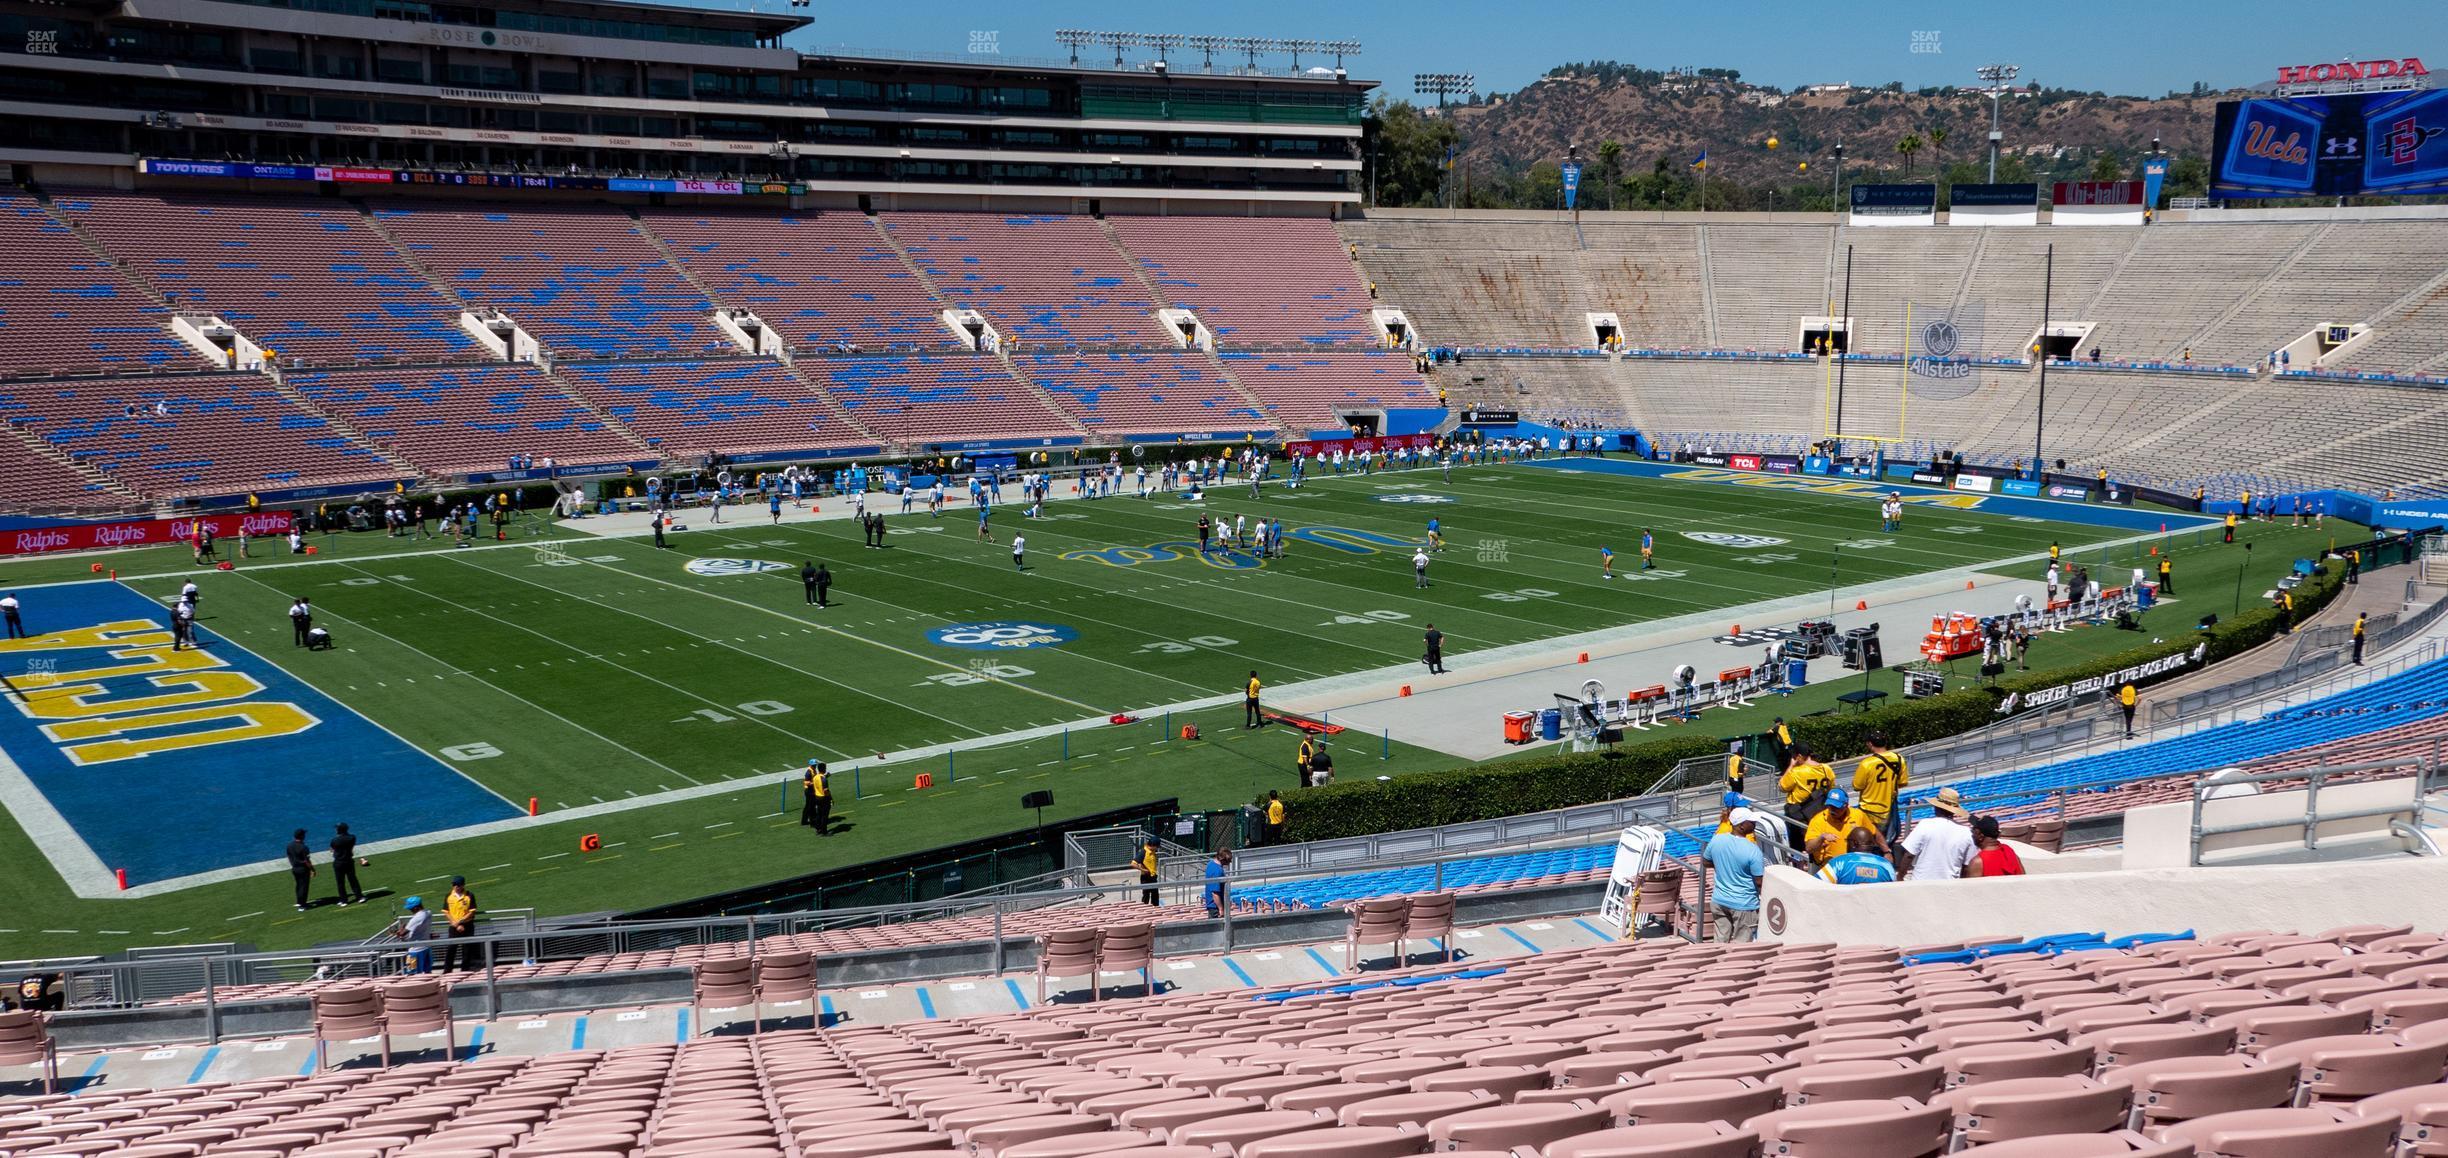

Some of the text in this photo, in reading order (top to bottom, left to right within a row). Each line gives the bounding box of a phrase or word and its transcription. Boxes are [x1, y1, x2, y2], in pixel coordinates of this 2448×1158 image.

[430, 28, 545, 48] ROSE BOWL
[2276, 57, 2430, 85] HONDA
[2245, 121, 2308, 165] Ucla
[155, 163, 224, 174] TOYO TIRES
[252, 166, 296, 175] ONTARIO
[523, 177, 547, 187] 76:41
[683, 181, 705, 191] TCL
[714, 182, 738, 191] TCL
[2328, 327, 2348, 343] 40
[1909, 358, 1970, 379] Allstate
[1353, 440, 1374, 451] Ralphs
[570, 464, 628, 474] UNDER ARMOUR
[1696, 456, 1724, 465] NISSAN
[1734, 458, 1756, 468] TCL
[1659, 469, 1989, 509] UCLA
[2395, 509, 2429, 518] UNDER
[170, 519, 219, 539] Ralhs
[242, 515, 289, 533] Ralphs
[15, 530, 69, 551] Ralphs
[95, 524, 146, 545] Ralphs
[1479, 588, 1560, 602] 50
[1334, 609, 1412, 625] 40
[940, 624, 1056, 644] 100
[1141, 635, 1240, 653] 30
[926, 664, 1036, 687] 20
[2024, 652, 2188, 708] SPIEKER FIELD AT THE ROSE BOWL
[0, 619, 323, 767] UCLA
[692, 700, 796, 723] 10
[1521, 720, 1530, 733] G
[439, 741, 504, 761] G
[918, 774, 930, 787] 10
[584, 835, 599, 850] G
[1771, 904, 1782, 926] 2
